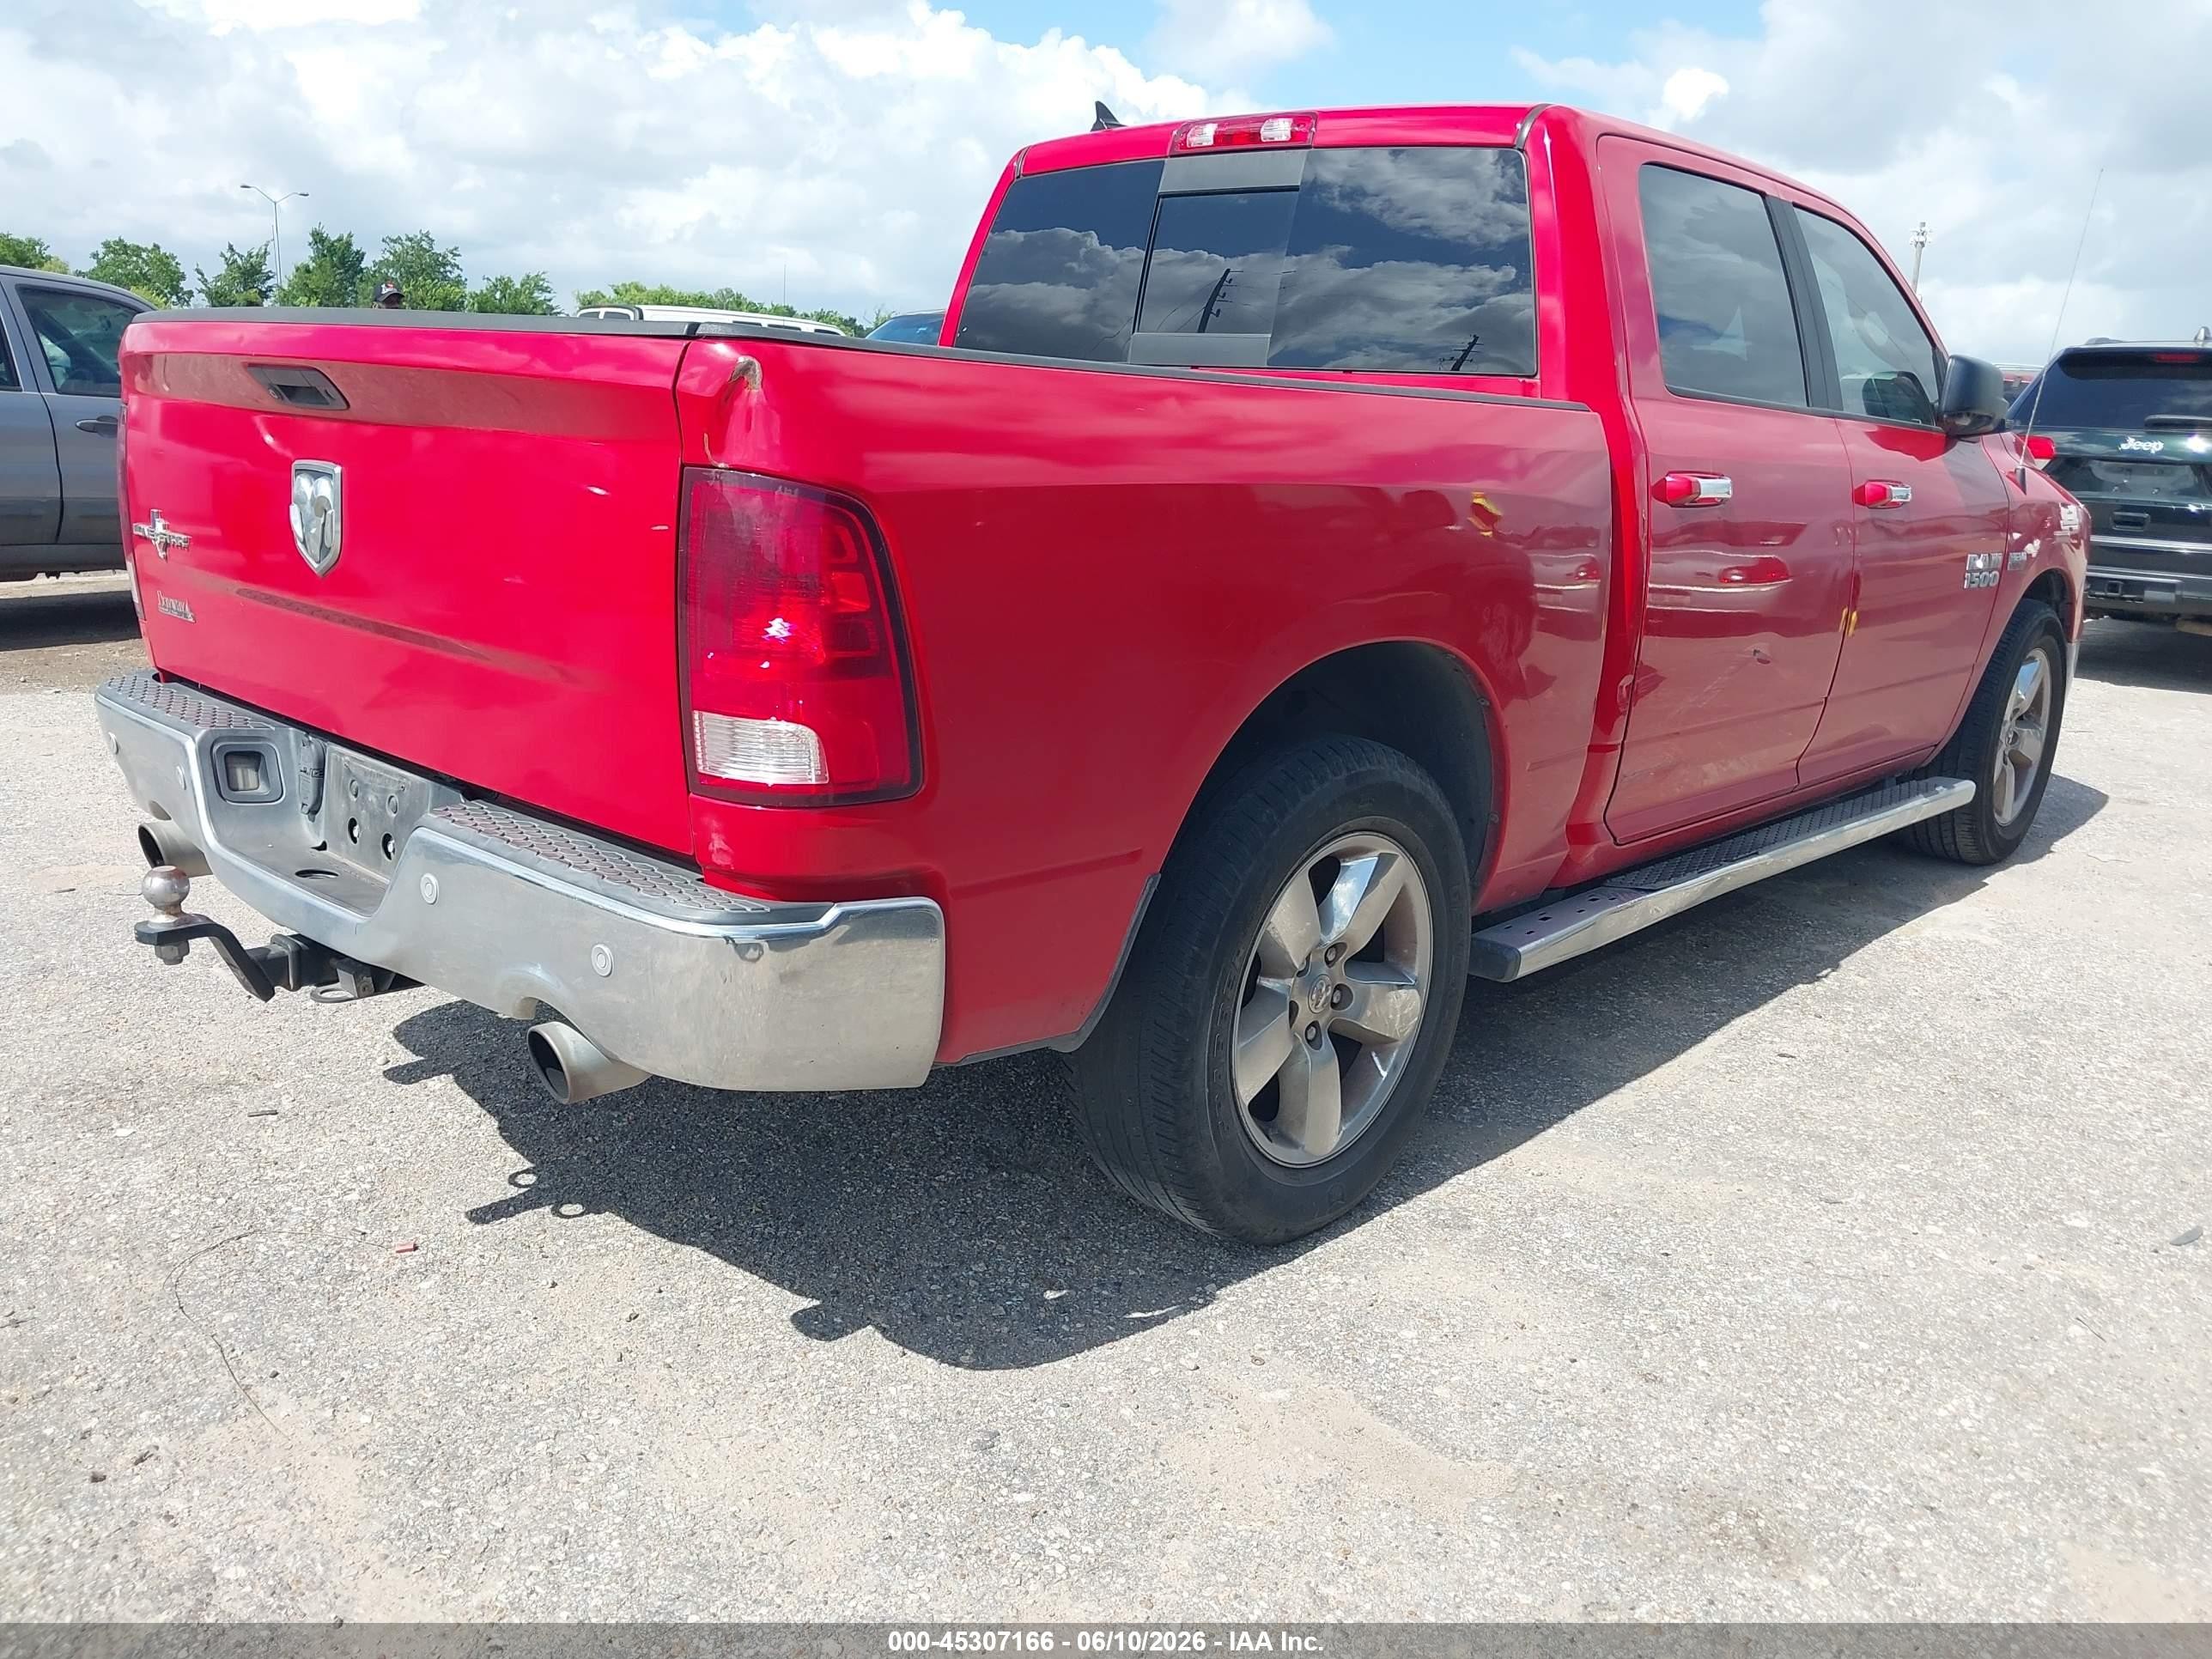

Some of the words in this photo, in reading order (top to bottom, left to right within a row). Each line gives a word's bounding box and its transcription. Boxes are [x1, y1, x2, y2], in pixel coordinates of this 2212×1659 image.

[2120, 436, 2165, 453] Jeep
[1966, 552, 2003, 570] RAM
[1964, 571, 2001, 589] 1500
